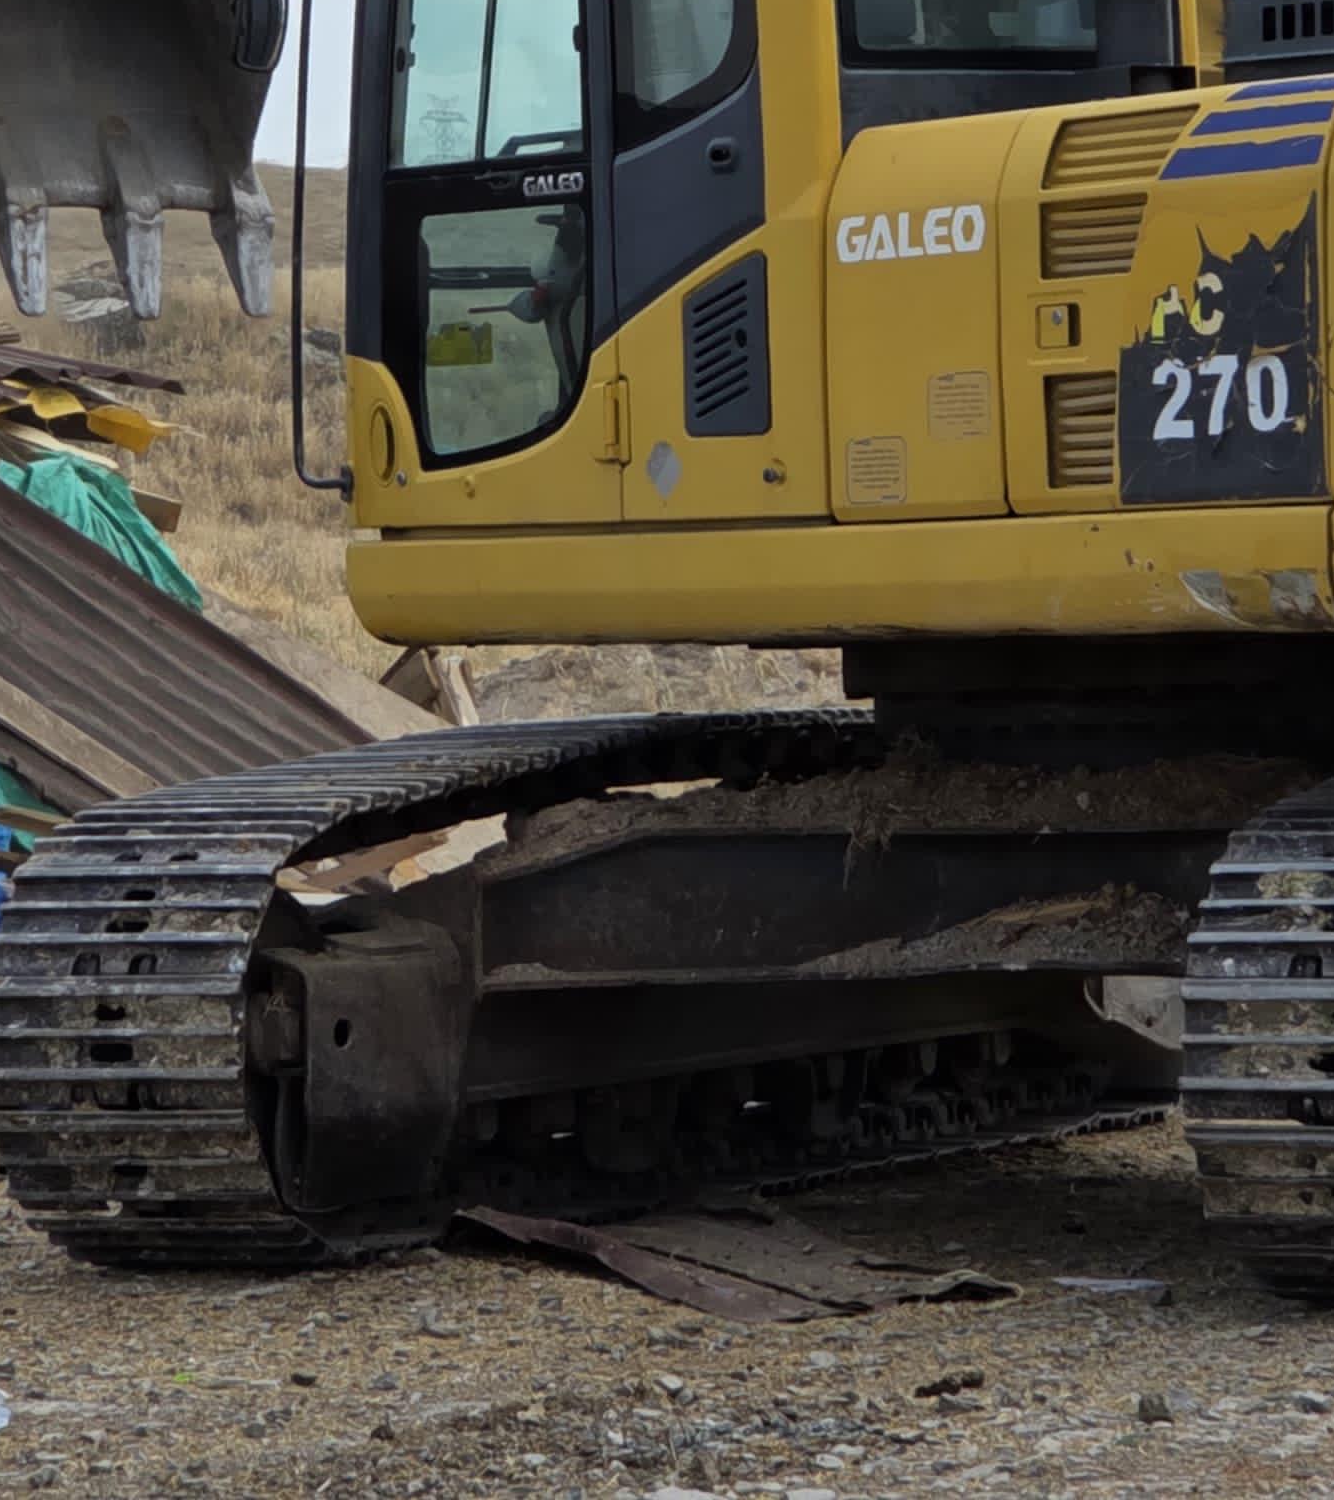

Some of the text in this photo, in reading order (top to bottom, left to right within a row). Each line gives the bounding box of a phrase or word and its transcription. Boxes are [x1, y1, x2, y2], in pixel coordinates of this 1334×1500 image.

[523, 171, 584, 197] GALEO
[836, 204, 986, 264] GALEO
[1152, 354, 1289, 441] 270
